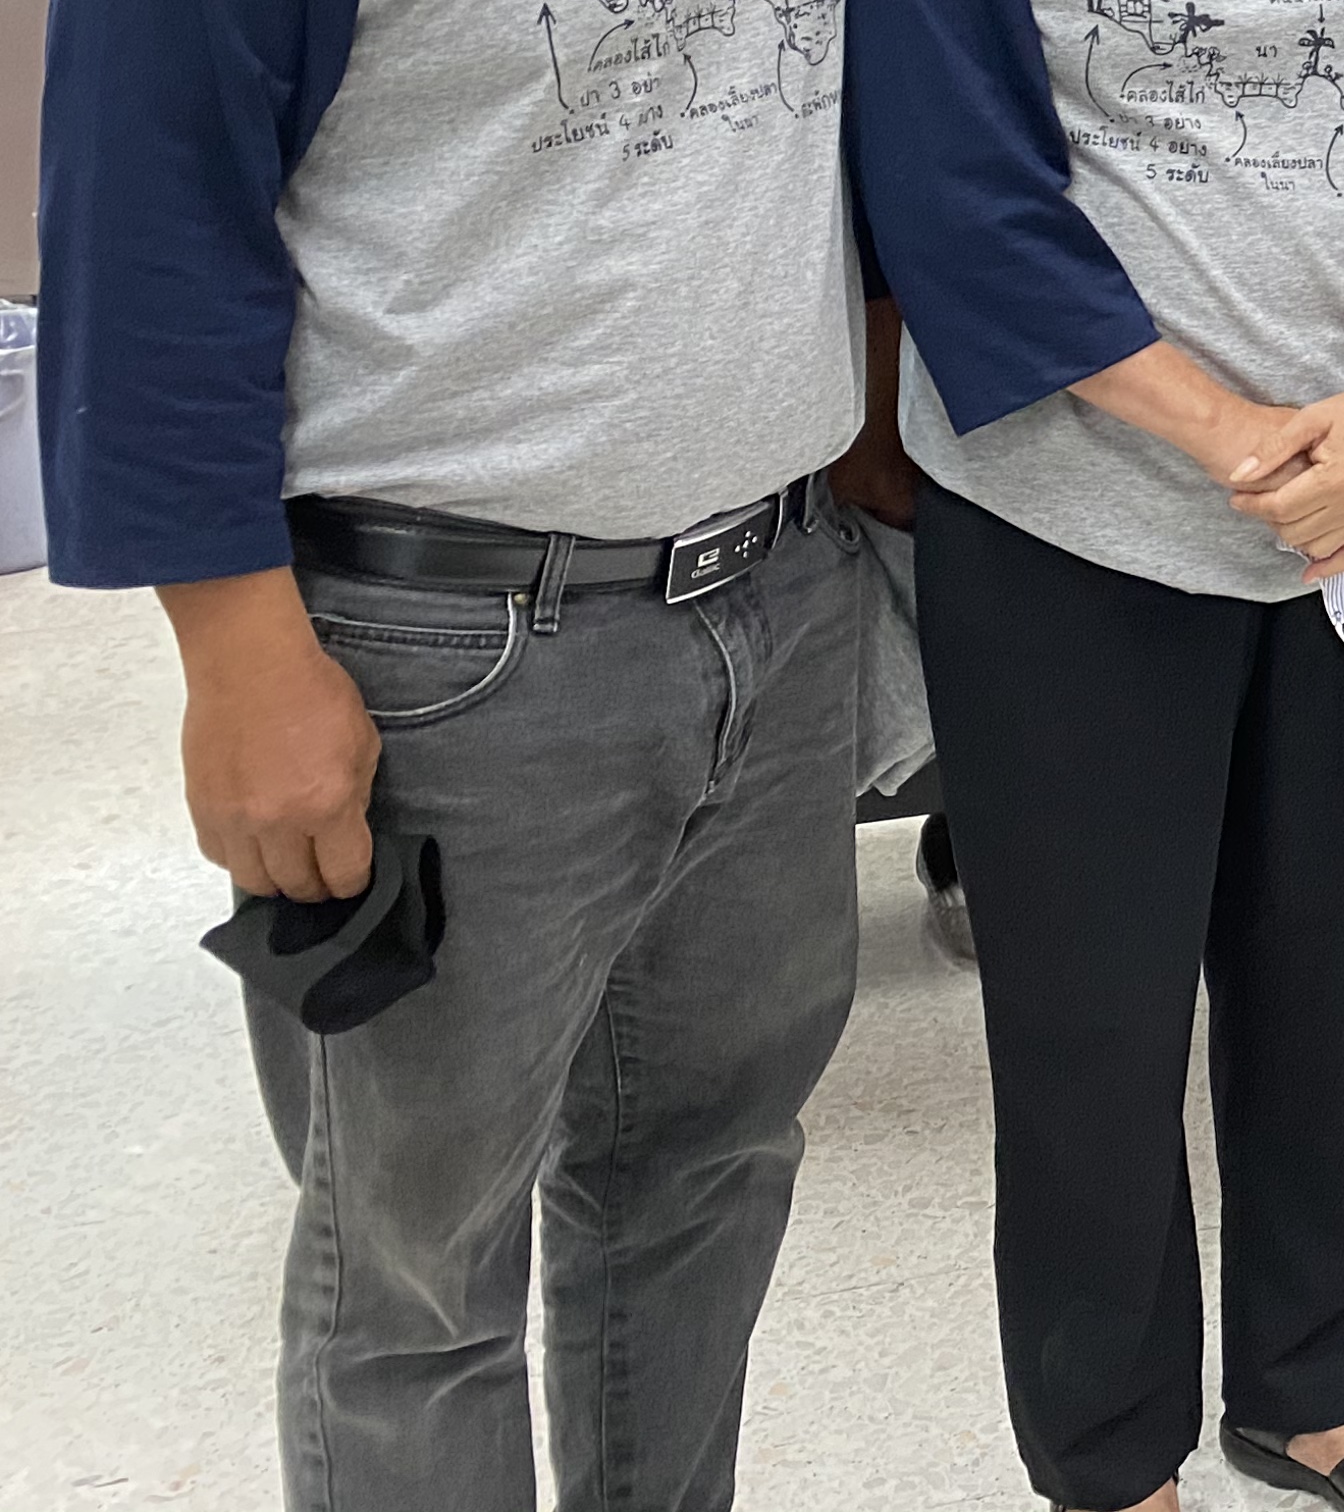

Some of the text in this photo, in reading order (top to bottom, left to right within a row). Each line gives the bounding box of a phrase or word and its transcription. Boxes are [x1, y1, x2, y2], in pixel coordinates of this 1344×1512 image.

[1255, 45, 1278, 58] นา
[609, 80, 622, 100] 3
[619, 113, 631, 131] 4
[621, 142, 631, 162] 5
[1149, 136, 1160, 153] 4
[1145, 162, 1210, 184] 5 ระดับ
